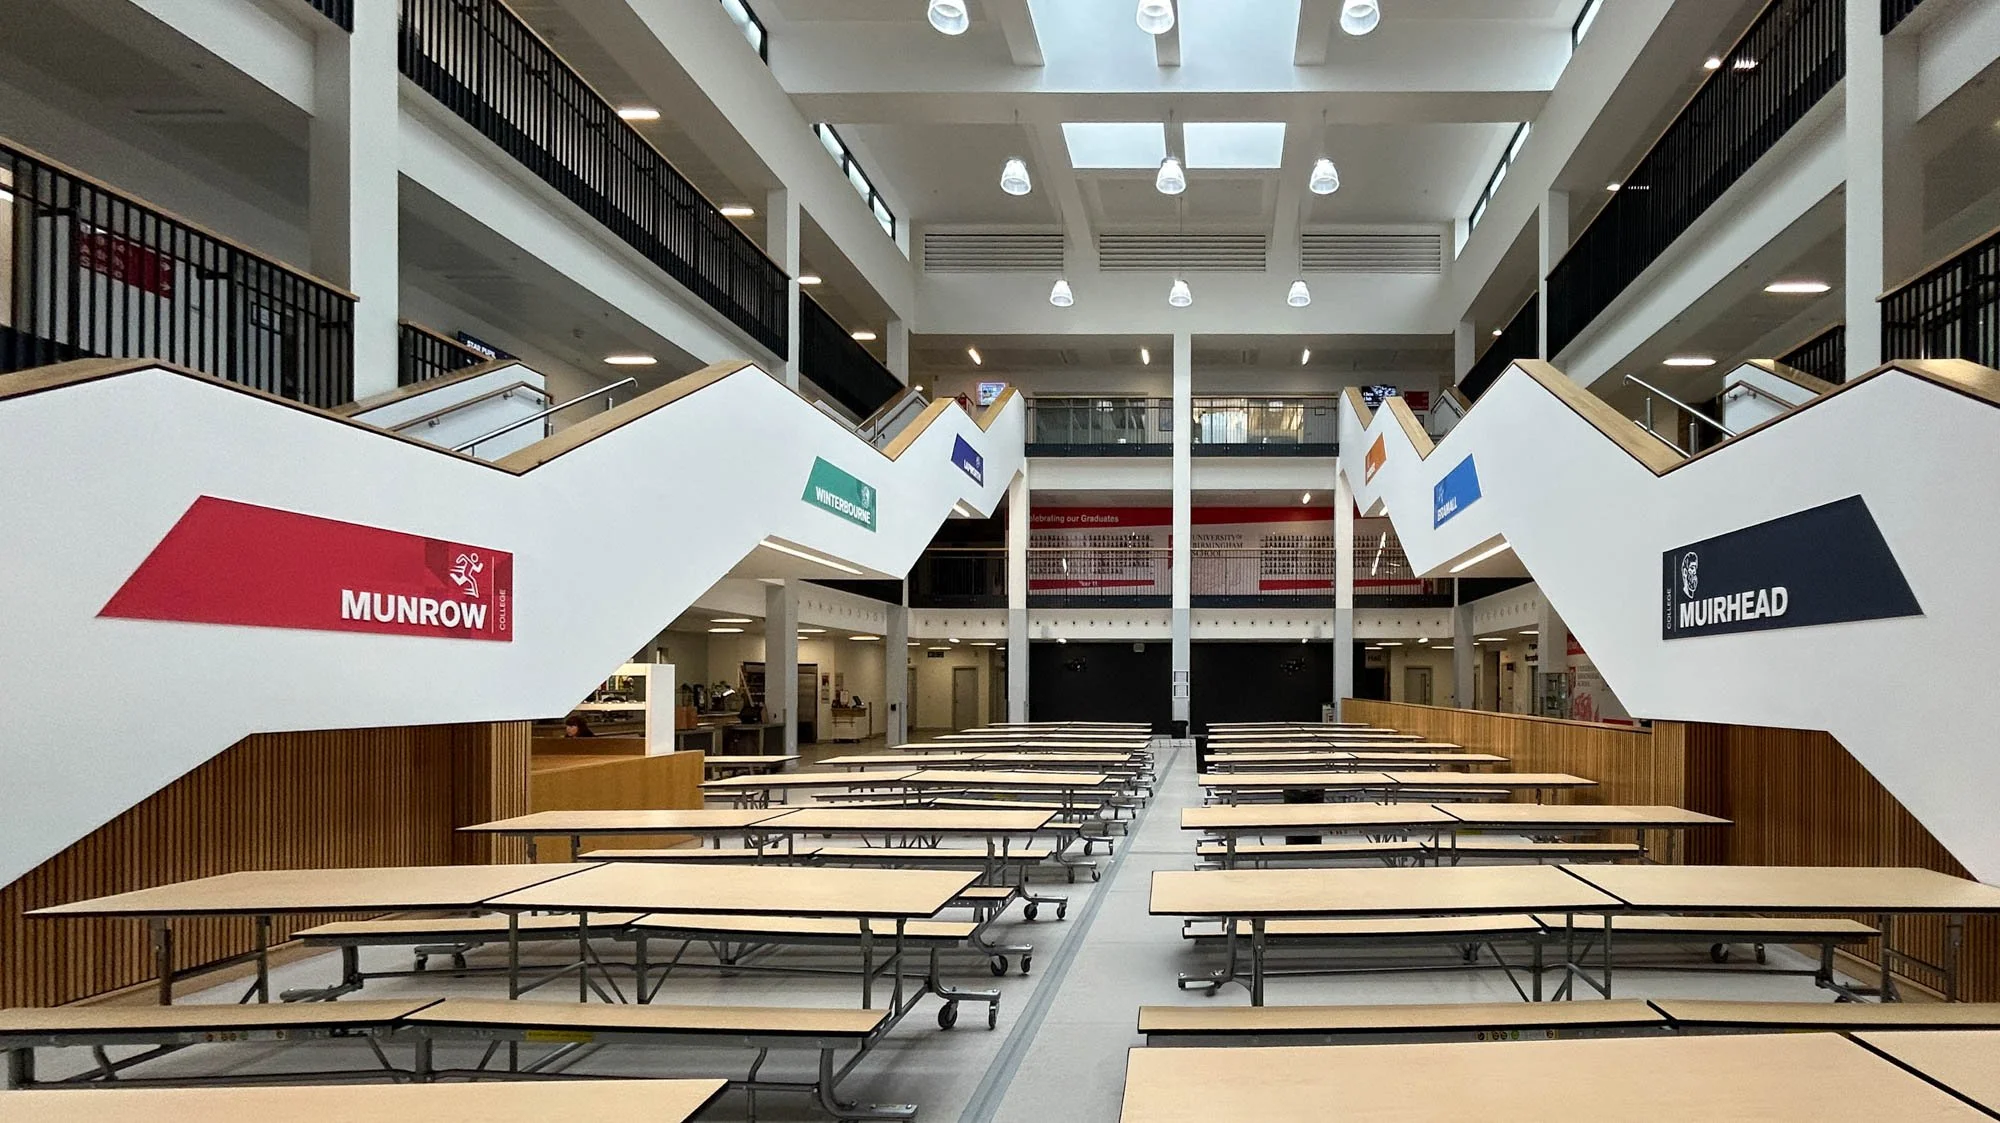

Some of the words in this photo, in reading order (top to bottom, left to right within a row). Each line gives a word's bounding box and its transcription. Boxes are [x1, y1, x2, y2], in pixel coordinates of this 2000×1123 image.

[815, 486, 871, 524] WINTERBOURNE
[1030, 514, 1065, 524] elebrating
[1066, 515, 1079, 523] our
[1080, 514, 1119, 523] Graduates
[1192, 534, 1235, 542] UNIVERSITY
[341, 589, 488, 630] MUNROW
[499, 589, 507, 631] COLLEGE
[1679, 586, 1789, 629] MUIRHEAD
